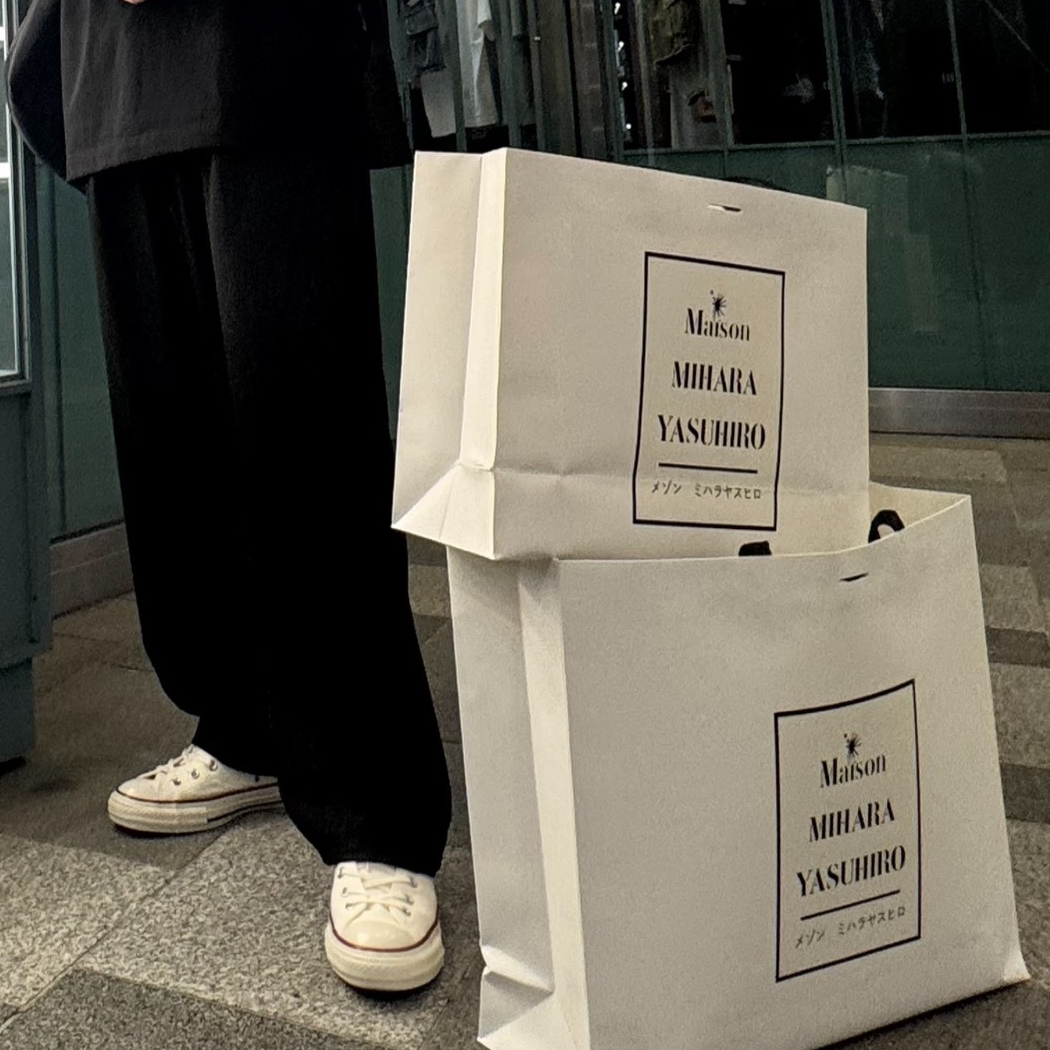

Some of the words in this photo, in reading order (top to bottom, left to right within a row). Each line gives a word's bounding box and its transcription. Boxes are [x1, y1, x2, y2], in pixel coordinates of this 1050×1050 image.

[685, 308, 750, 341] Maison
[672, 361, 757, 396] MIHARA
[658, 414, 766, 450] YASUHIRO
[651, 480, 682, 495] メゾン
[695, 483, 761, 500] ミハラヤスヒロ
[820, 753, 886, 788] Maison
[809, 798, 895, 843] MIHARA
[796, 845, 906, 897] YASUHIRO
[795, 928, 826, 948] メゾン
[838, 906, 906, 935] ミハラヤスヒロ
